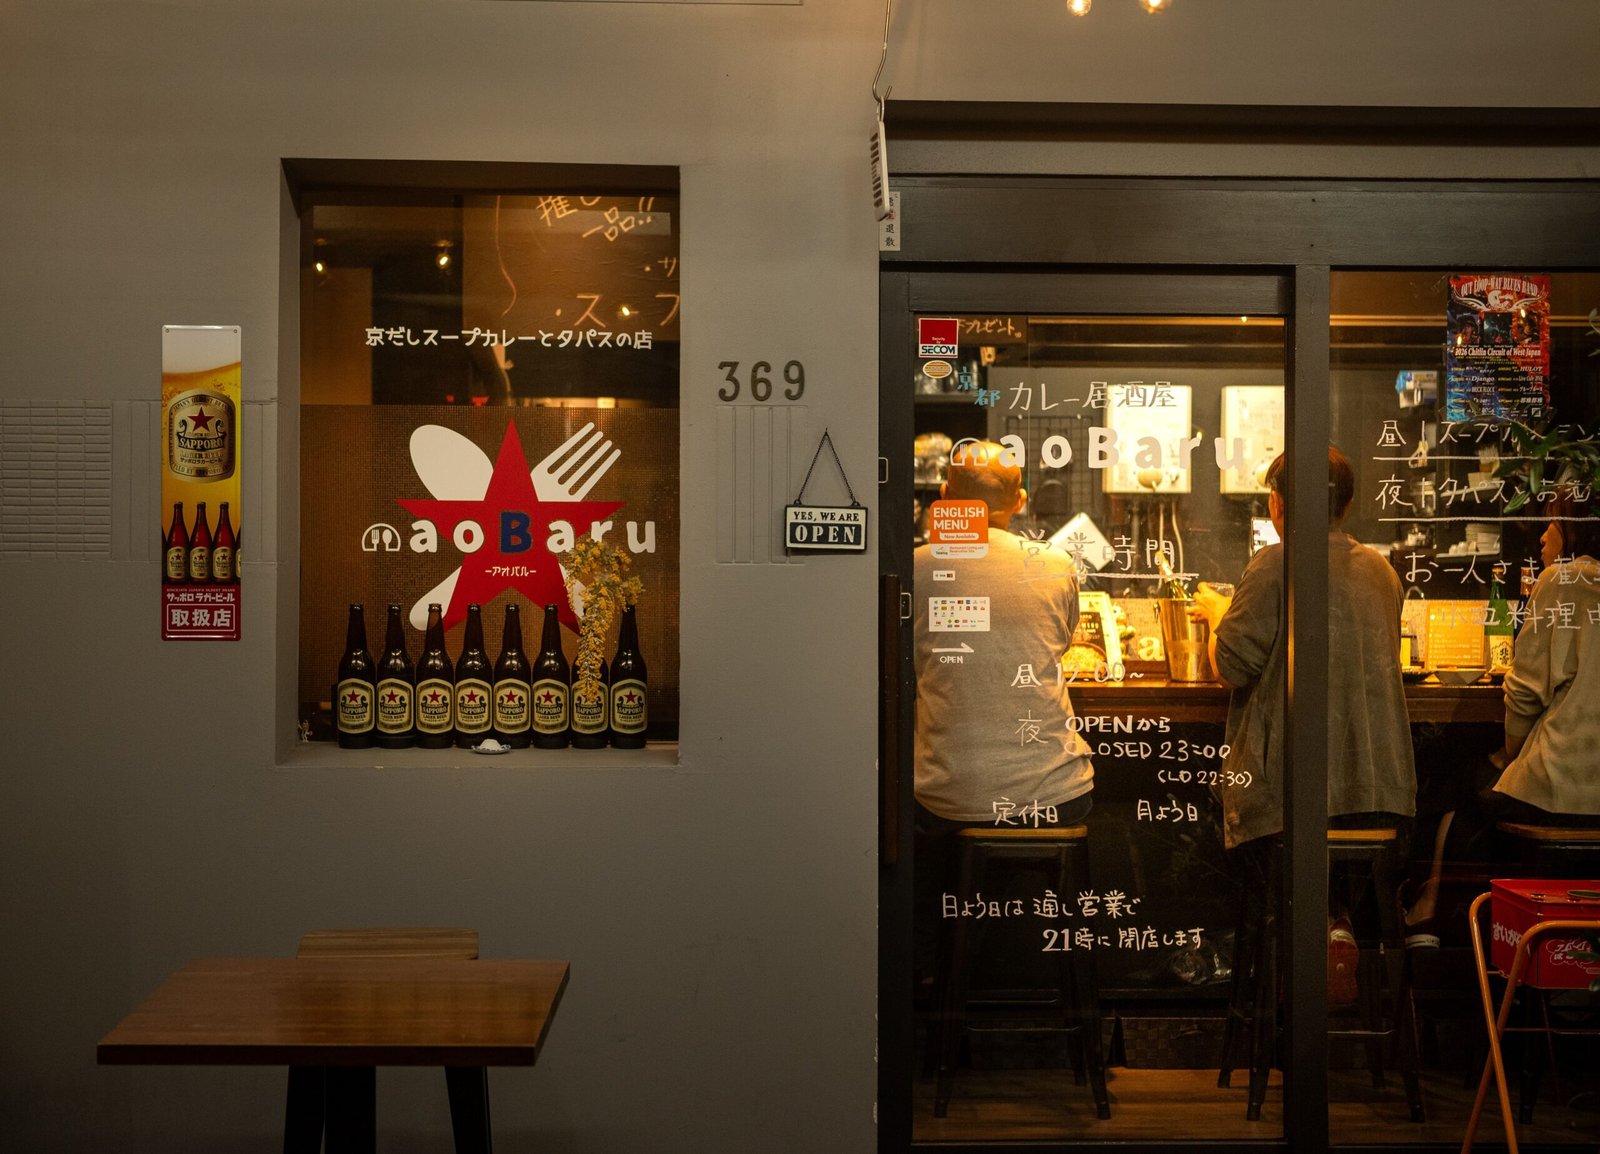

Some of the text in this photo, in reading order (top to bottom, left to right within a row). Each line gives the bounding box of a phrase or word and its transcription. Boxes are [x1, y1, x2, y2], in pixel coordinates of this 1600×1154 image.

[365, 326, 653, 350] 京だしスープカレーとタパスの店
[922, 345, 956, 354] SECOM
[718, 360, 806, 402] 369
[1008, 381, 1178, 412] カレー居酒屋
[178, 438, 224, 450] SAPPORO
[1376, 420, 1407, 447] 昼
[999, 426, 1244, 470] aoBaru
[1375, 474, 1413, 510] 夜
[793, 510, 860, 524] YES, WE ARE
[933, 506, 985, 518] ENGLISH
[409, 511, 656, 554] aoBaru
[796, 525, 856, 544] OPEN
[933, 519, 969, 531] MENU
[1018, 528, 1176, 572] 営業時間
[1404, 552, 1600, 586] お一人さま歓
[166, 592, 236, 602] サッポロ ラガービール
[170, 608, 232, 628] 取扱店
[940, 656, 964, 664] OPEN
[1010, 663, 1042, 688] 昼
[1015, 709, 1048, 748] 夜
[1158, 740, 1231, 761] 23:00
[992, 796, 1198, 828] 定休日 月よう日
